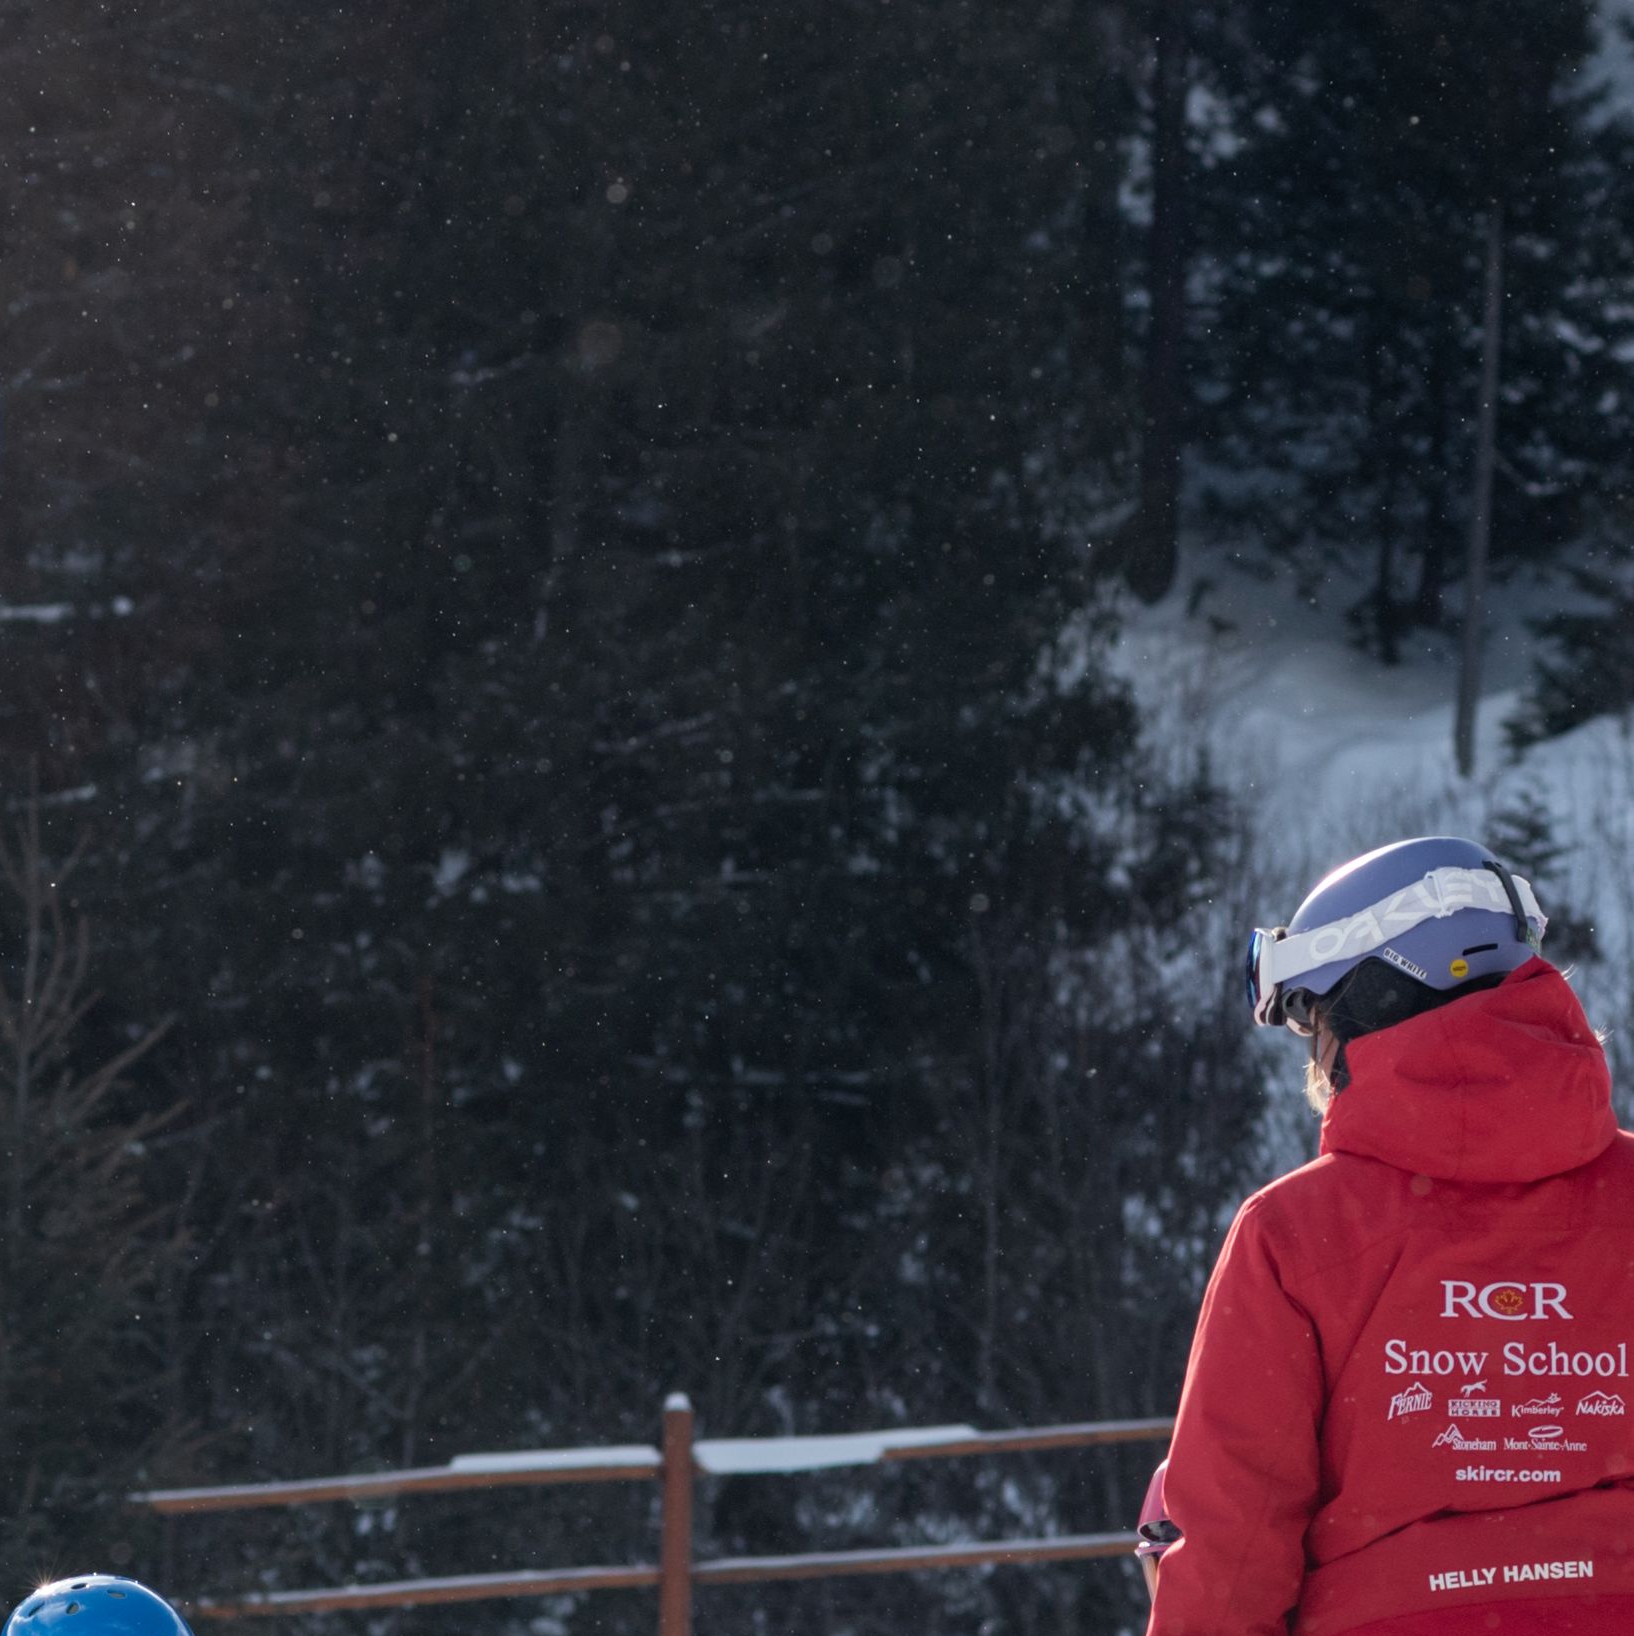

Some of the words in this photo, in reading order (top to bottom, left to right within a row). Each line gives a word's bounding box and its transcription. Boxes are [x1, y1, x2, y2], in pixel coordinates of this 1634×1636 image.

[1384, 949, 1400, 962] BIG
[1400, 959, 1426, 978] WHITE
[1439, 1280, 1573, 1321] RCR
[1384, 1339, 1489, 1376] Snow
[1503, 1342, 1629, 1377] School
[1387, 1392, 1433, 1420] FERNIE
[1451, 1400, 1498, 1408] KICKING
[1511, 1404, 1564, 1417] Kimberley
[1452, 1438, 1496, 1450] Stoneham
[1455, 1465, 1561, 1482] skircr.com
[1429, 1567, 1496, 1591] HELLY
[1503, 1560, 1593, 1583] HANSEN
